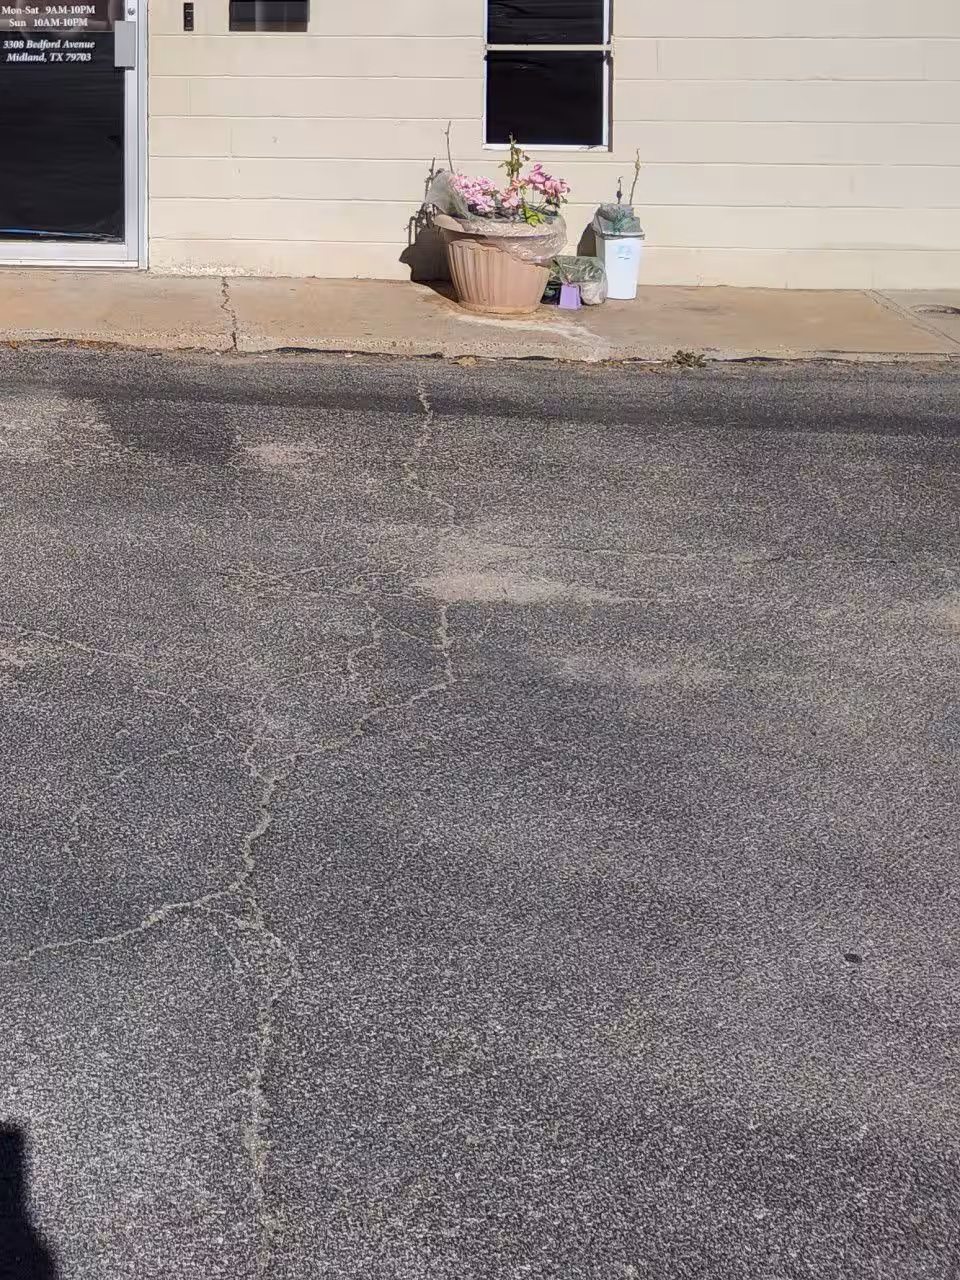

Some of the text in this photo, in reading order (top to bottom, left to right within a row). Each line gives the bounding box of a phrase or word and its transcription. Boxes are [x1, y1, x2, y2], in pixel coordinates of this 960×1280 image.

[1, 5, 96, 15] Mon-Sat 9AM-10PM
[9, 18, 88, 27] Sun 10AM-10PM
[3, 39, 96, 51] 3308 Bedford Avenue
[6, 52, 92, 63] Midland, TX 79703
